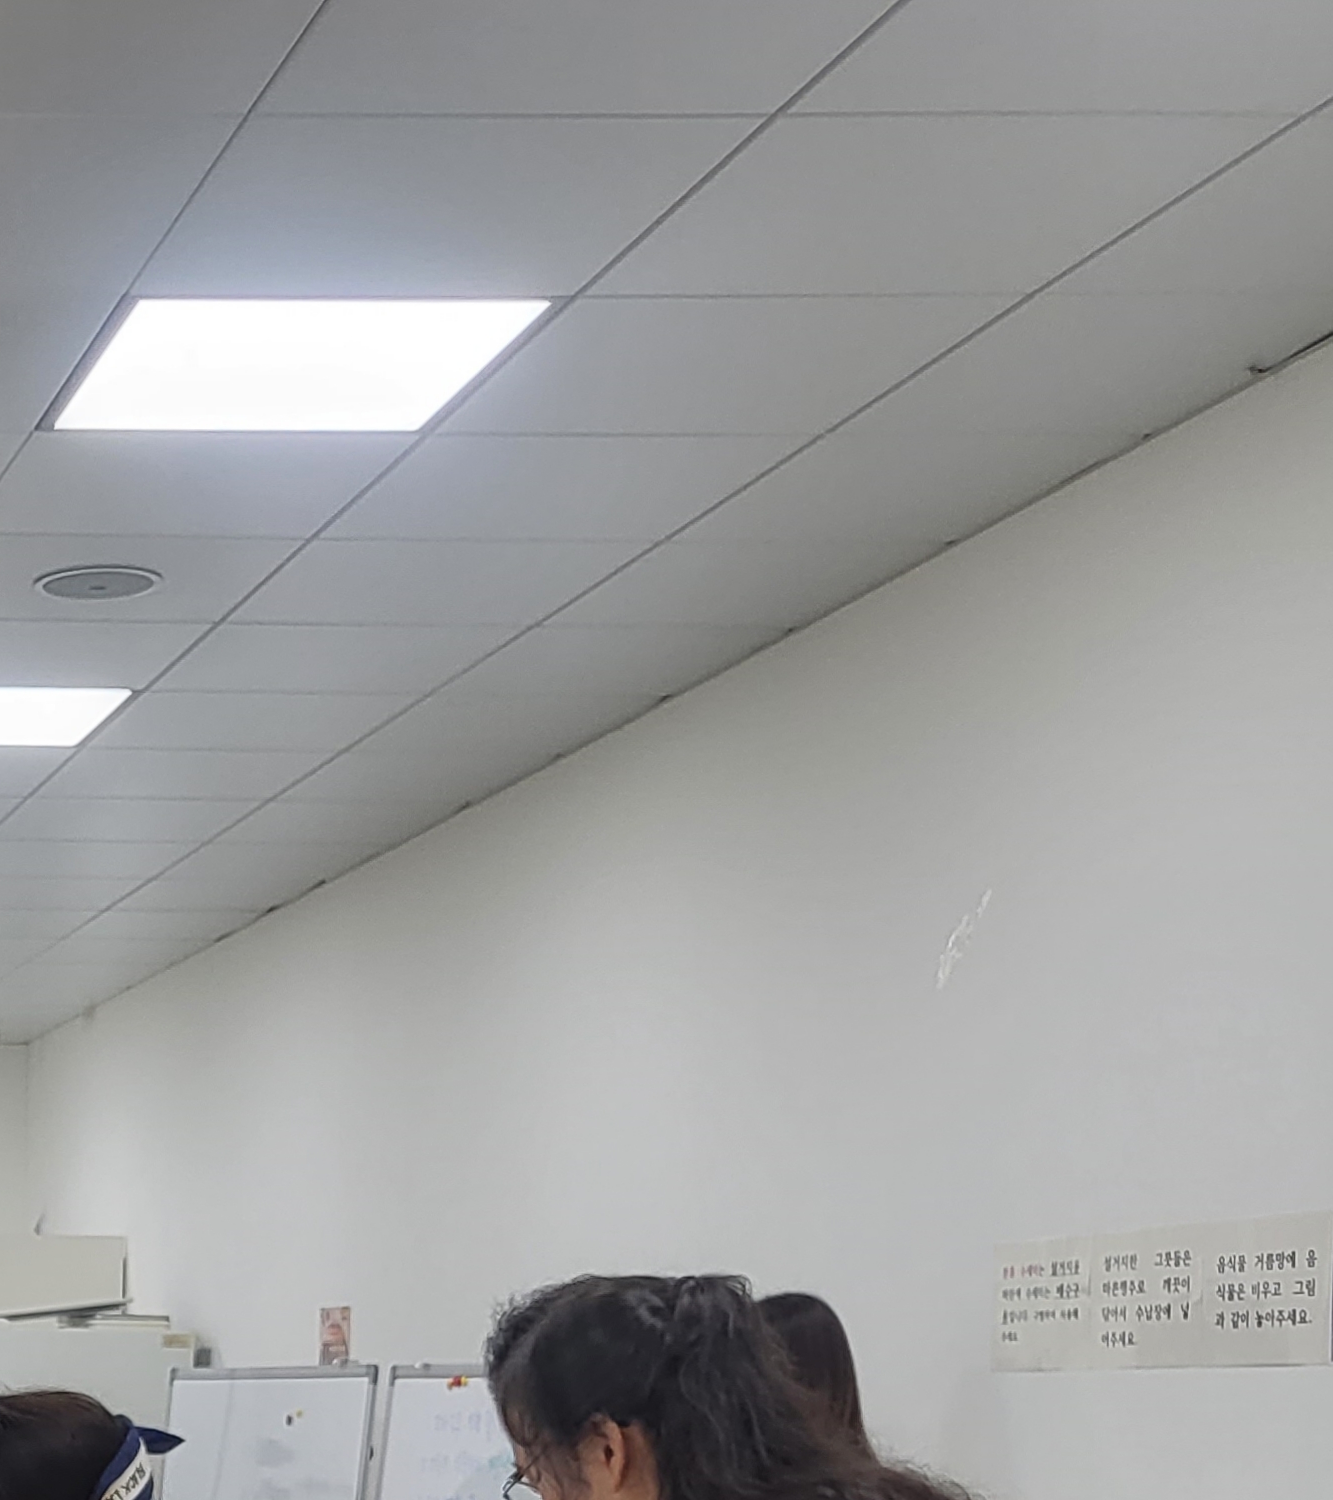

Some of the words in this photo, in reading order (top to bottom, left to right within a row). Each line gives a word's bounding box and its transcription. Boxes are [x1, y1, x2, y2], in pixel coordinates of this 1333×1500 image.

[1105, 1254, 1138, 1272] 설거지한
[1217, 1255, 1247, 1274] 음식물
[1254, 1251, 1296, 1270] 거름망에
[1306, 1249, 1317, 1267] 음
[1216, 1283, 1245, 1301] 식물은
[1251, 1281, 1282, 1300] 비우고
[1292, 1278, 1315, 1297] 그림
[1136, 1303, 1171, 1322] 수납장에
[1214, 1311, 1225, 1329] 과
